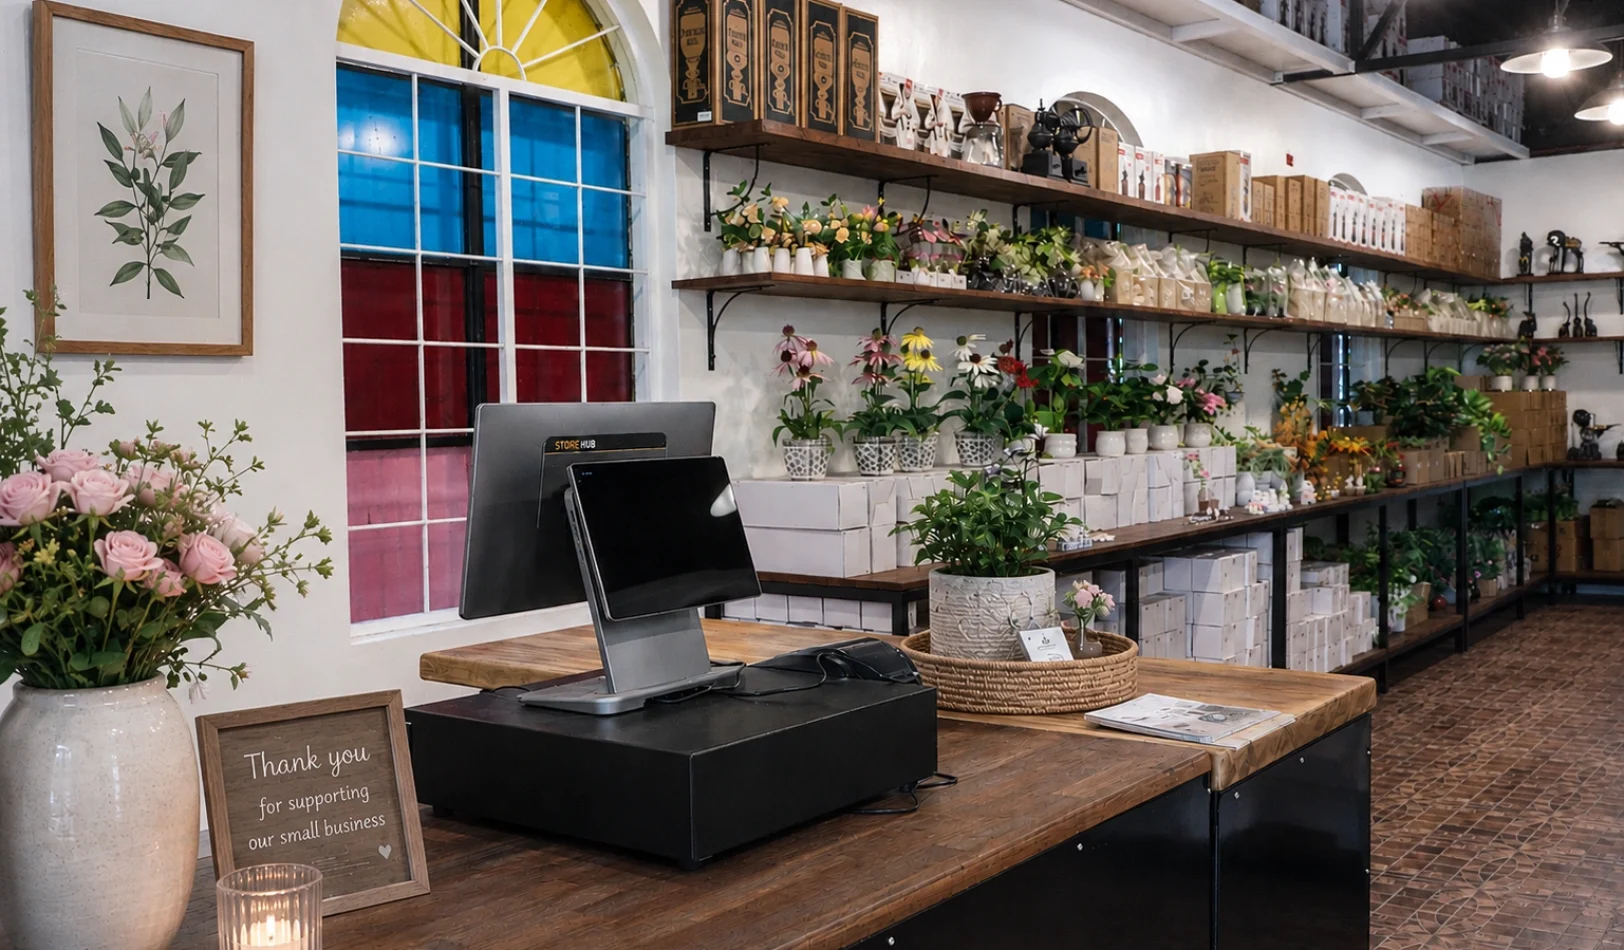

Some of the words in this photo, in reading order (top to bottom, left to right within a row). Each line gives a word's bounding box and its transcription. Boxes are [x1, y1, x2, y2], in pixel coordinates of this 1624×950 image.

[244, 745, 321, 779] Thank
[328, 746, 371, 777] you
[259, 796, 283, 821] for
[288, 785, 370, 812] supporting
[248, 835, 275, 851] our
[280, 820, 321, 845] small
[324, 814, 386, 837] business
